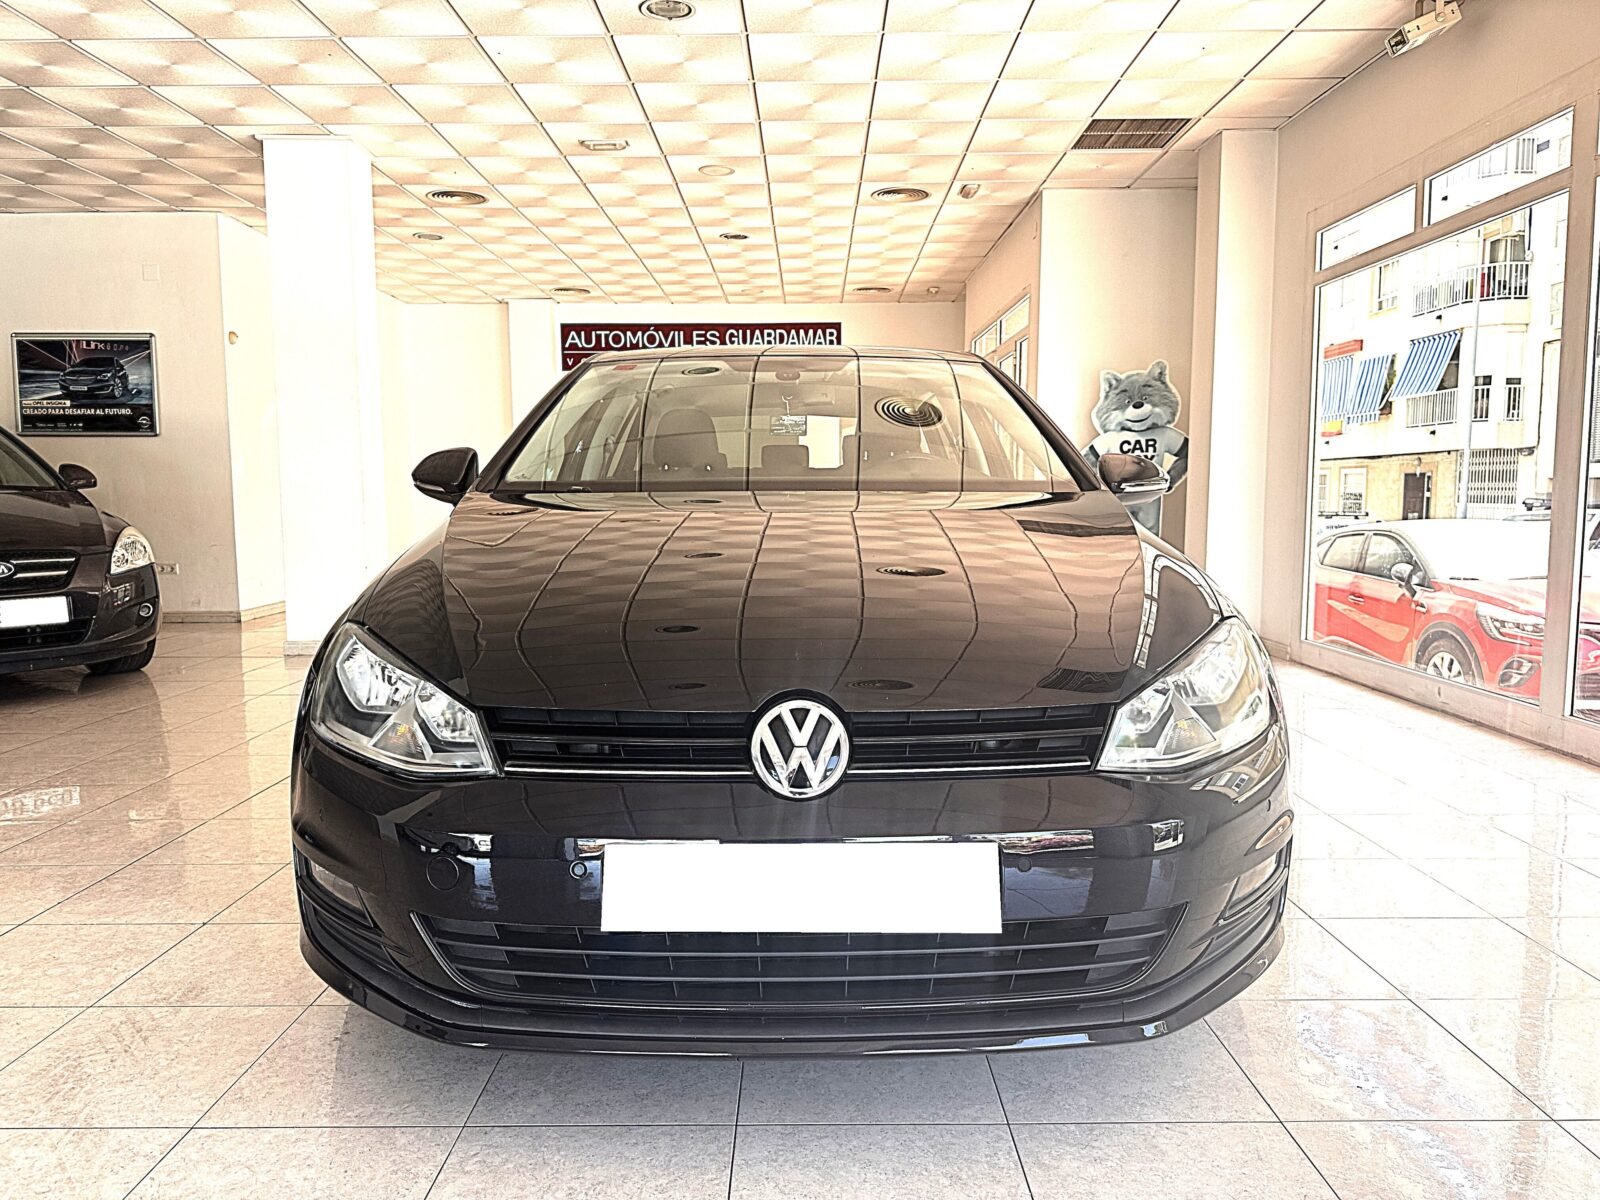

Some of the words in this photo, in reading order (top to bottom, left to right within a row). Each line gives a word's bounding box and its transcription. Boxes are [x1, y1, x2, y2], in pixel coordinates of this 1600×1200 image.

[565, 327, 720, 347] AUTOMÓVILES
[725, 329, 837, 345] GUARDAMAR
[1119, 438, 1157, 454] CAR
